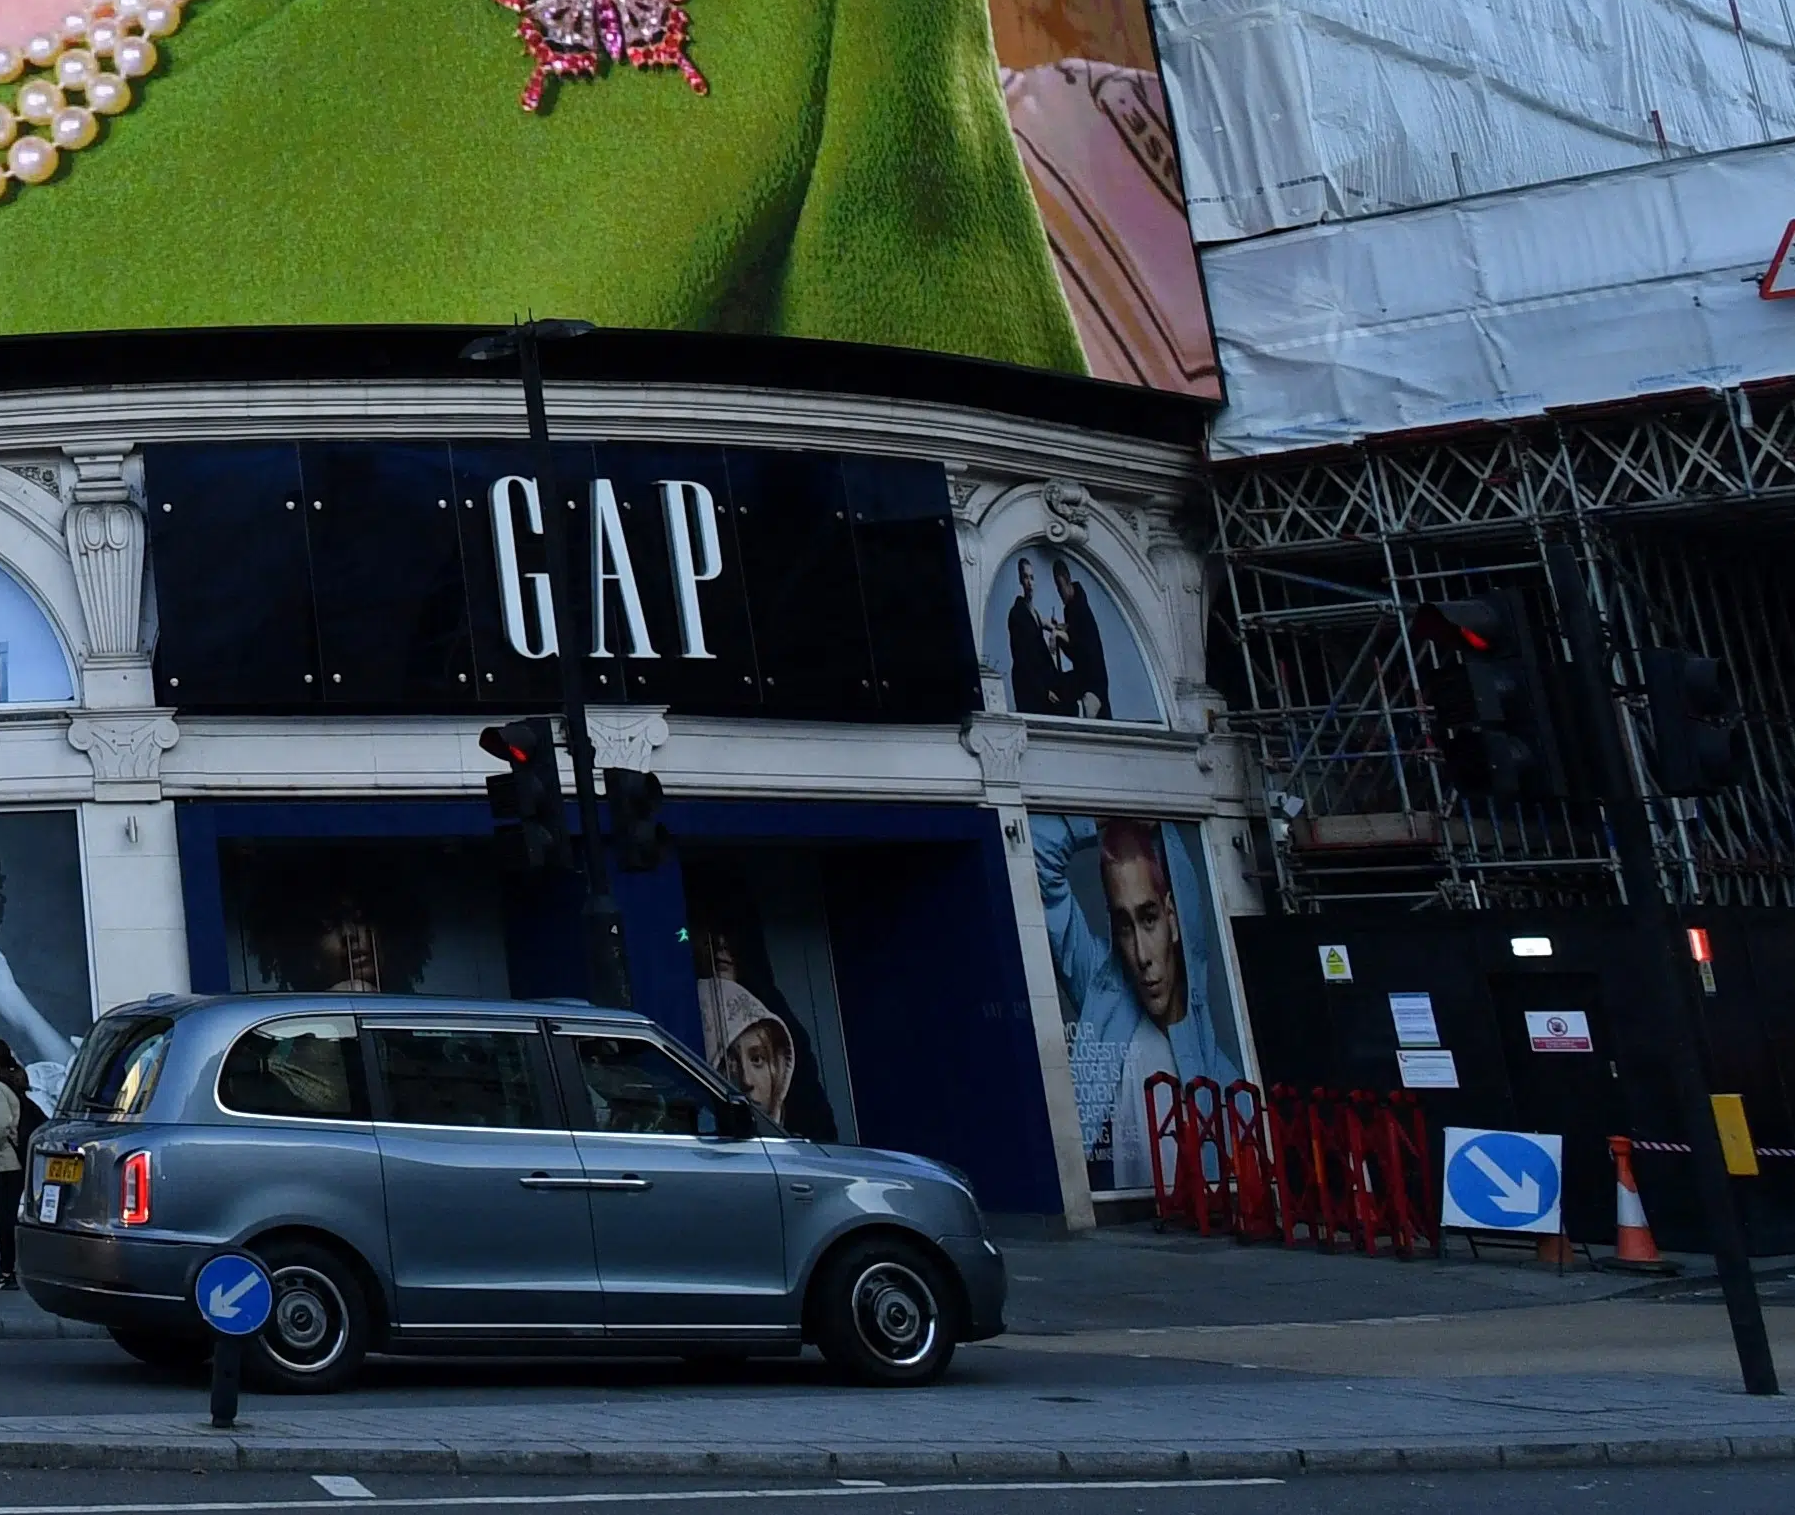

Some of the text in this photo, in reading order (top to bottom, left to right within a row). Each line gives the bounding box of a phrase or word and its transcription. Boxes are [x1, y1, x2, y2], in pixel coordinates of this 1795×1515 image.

[488, 475, 724, 660] GAP
[1063, 1021, 1095, 1041] YOUR
[1067, 1041, 1116, 1061] CLOSEST
[1070, 1063, 1108, 1082] STORE
[1074, 1083, 1118, 1103] COVENT
